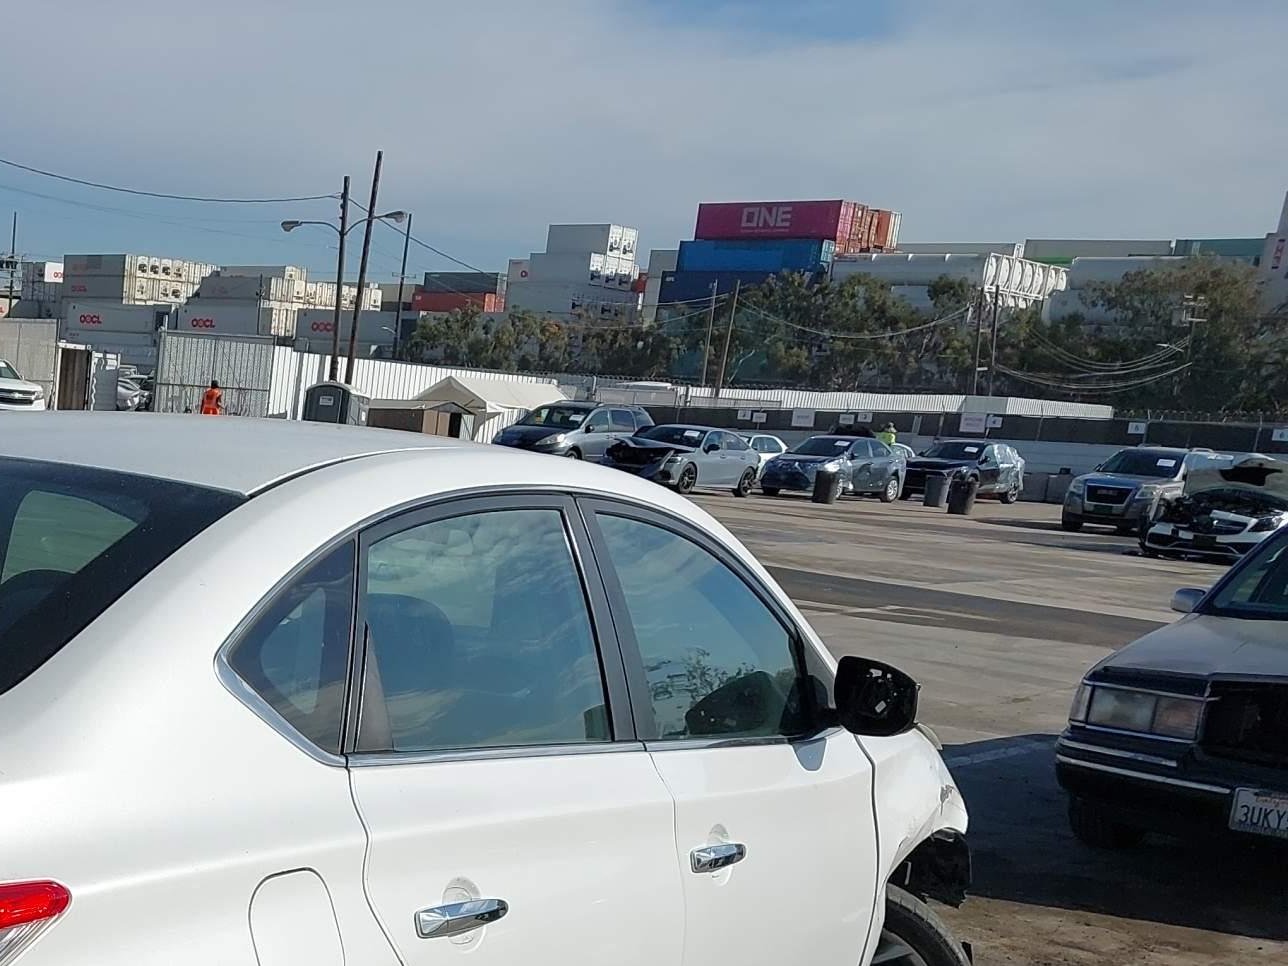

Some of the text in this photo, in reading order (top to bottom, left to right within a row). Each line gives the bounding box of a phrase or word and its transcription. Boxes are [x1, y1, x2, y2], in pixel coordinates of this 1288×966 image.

[741, 206, 792, 227] ONE
[79, 314, 102, 324] OOCL
[191, 318, 216, 328] OOCL
[312, 321, 334, 332] OOC
[1239, 804, 1288, 830] 3UKY
